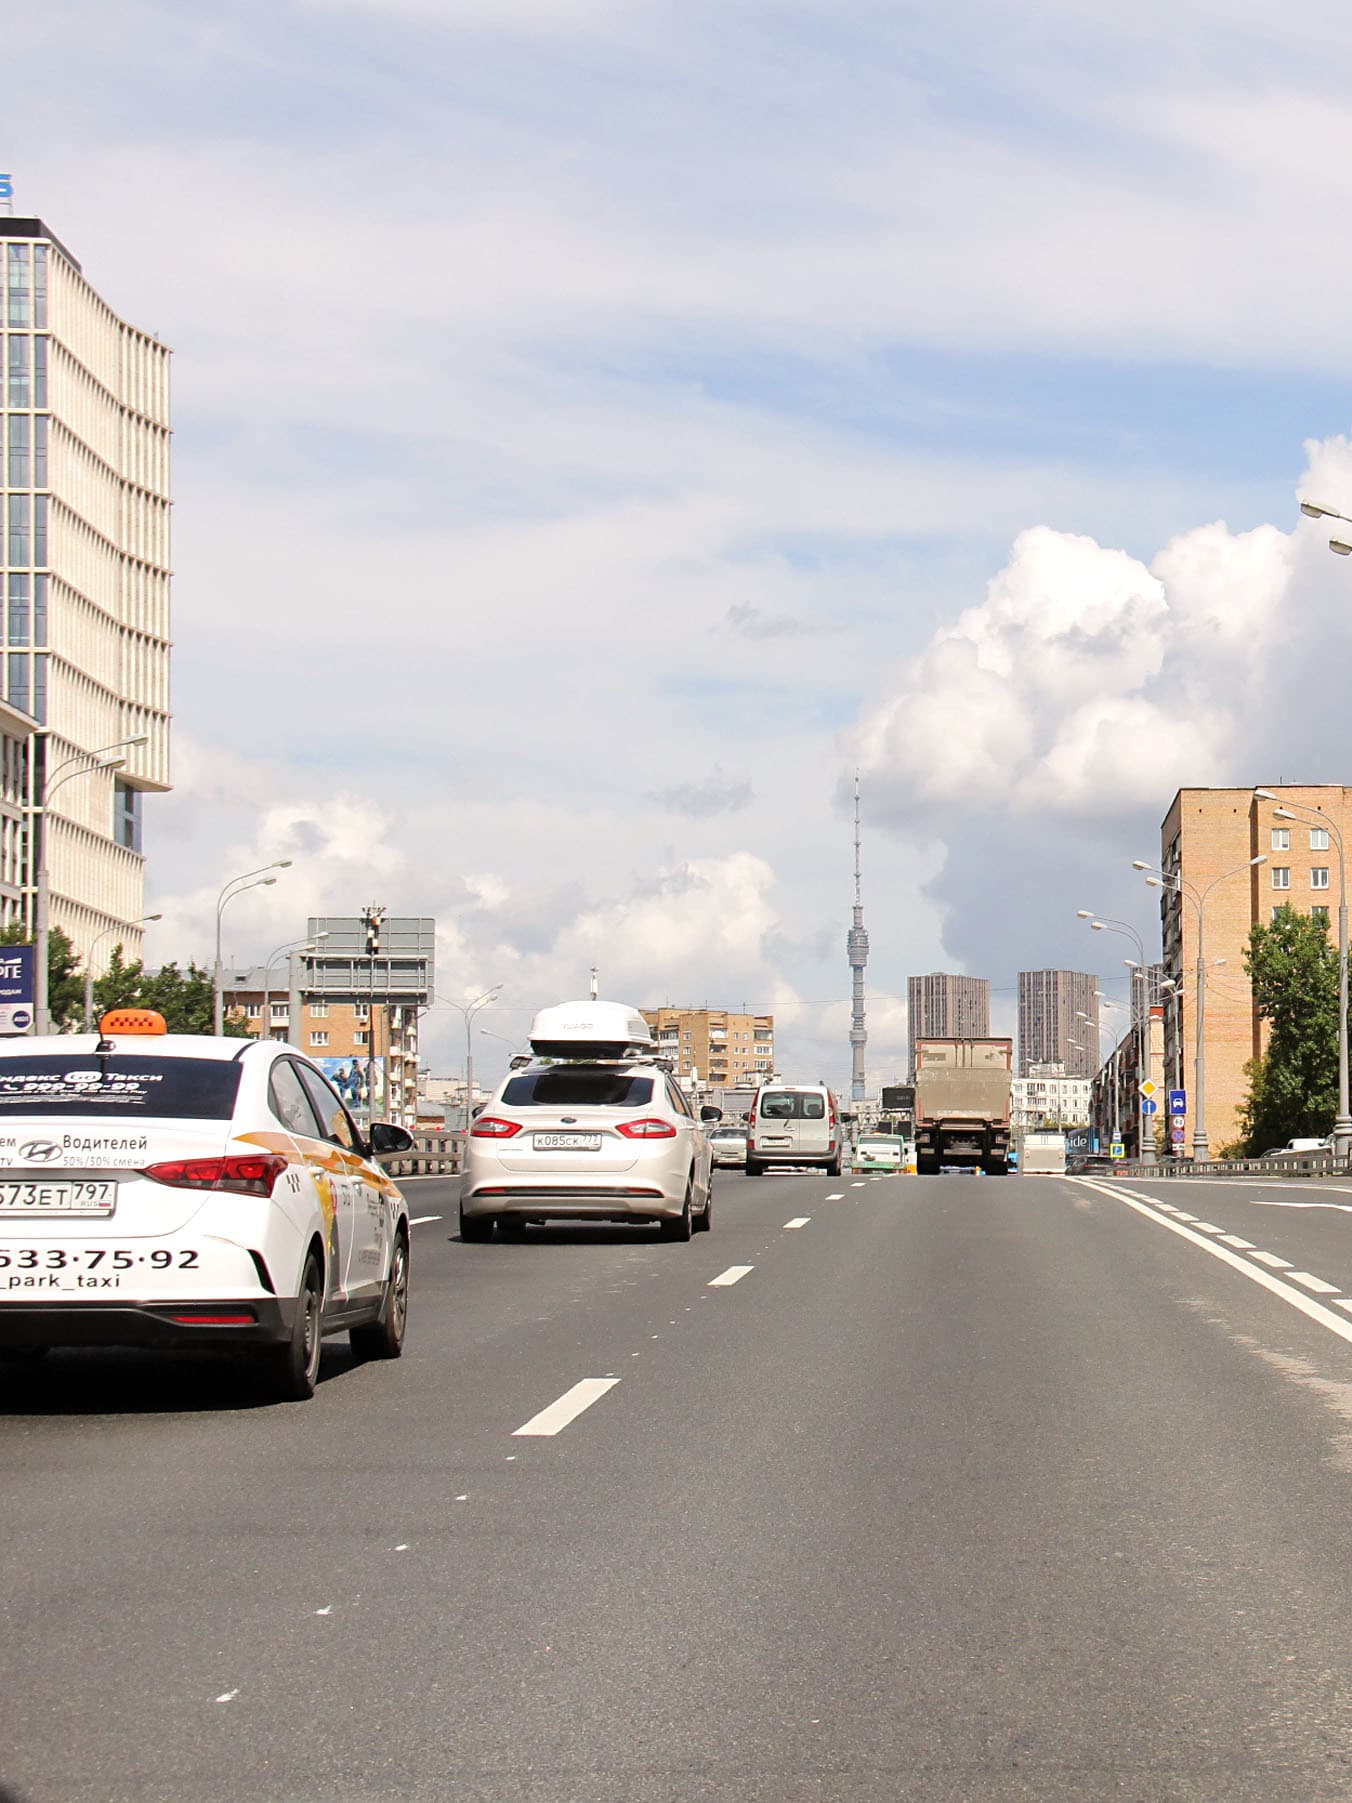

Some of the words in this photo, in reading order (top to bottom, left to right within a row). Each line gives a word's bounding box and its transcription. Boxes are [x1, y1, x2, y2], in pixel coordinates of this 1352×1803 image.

[105, 1072, 164, 1082] Такси
[63, 1135, 148, 1151] Водителей
[63, 1156, 111, 1168] 50%/50%
[113, 1158, 146, 1167] смена
[74, 1184, 110, 1200] 797
